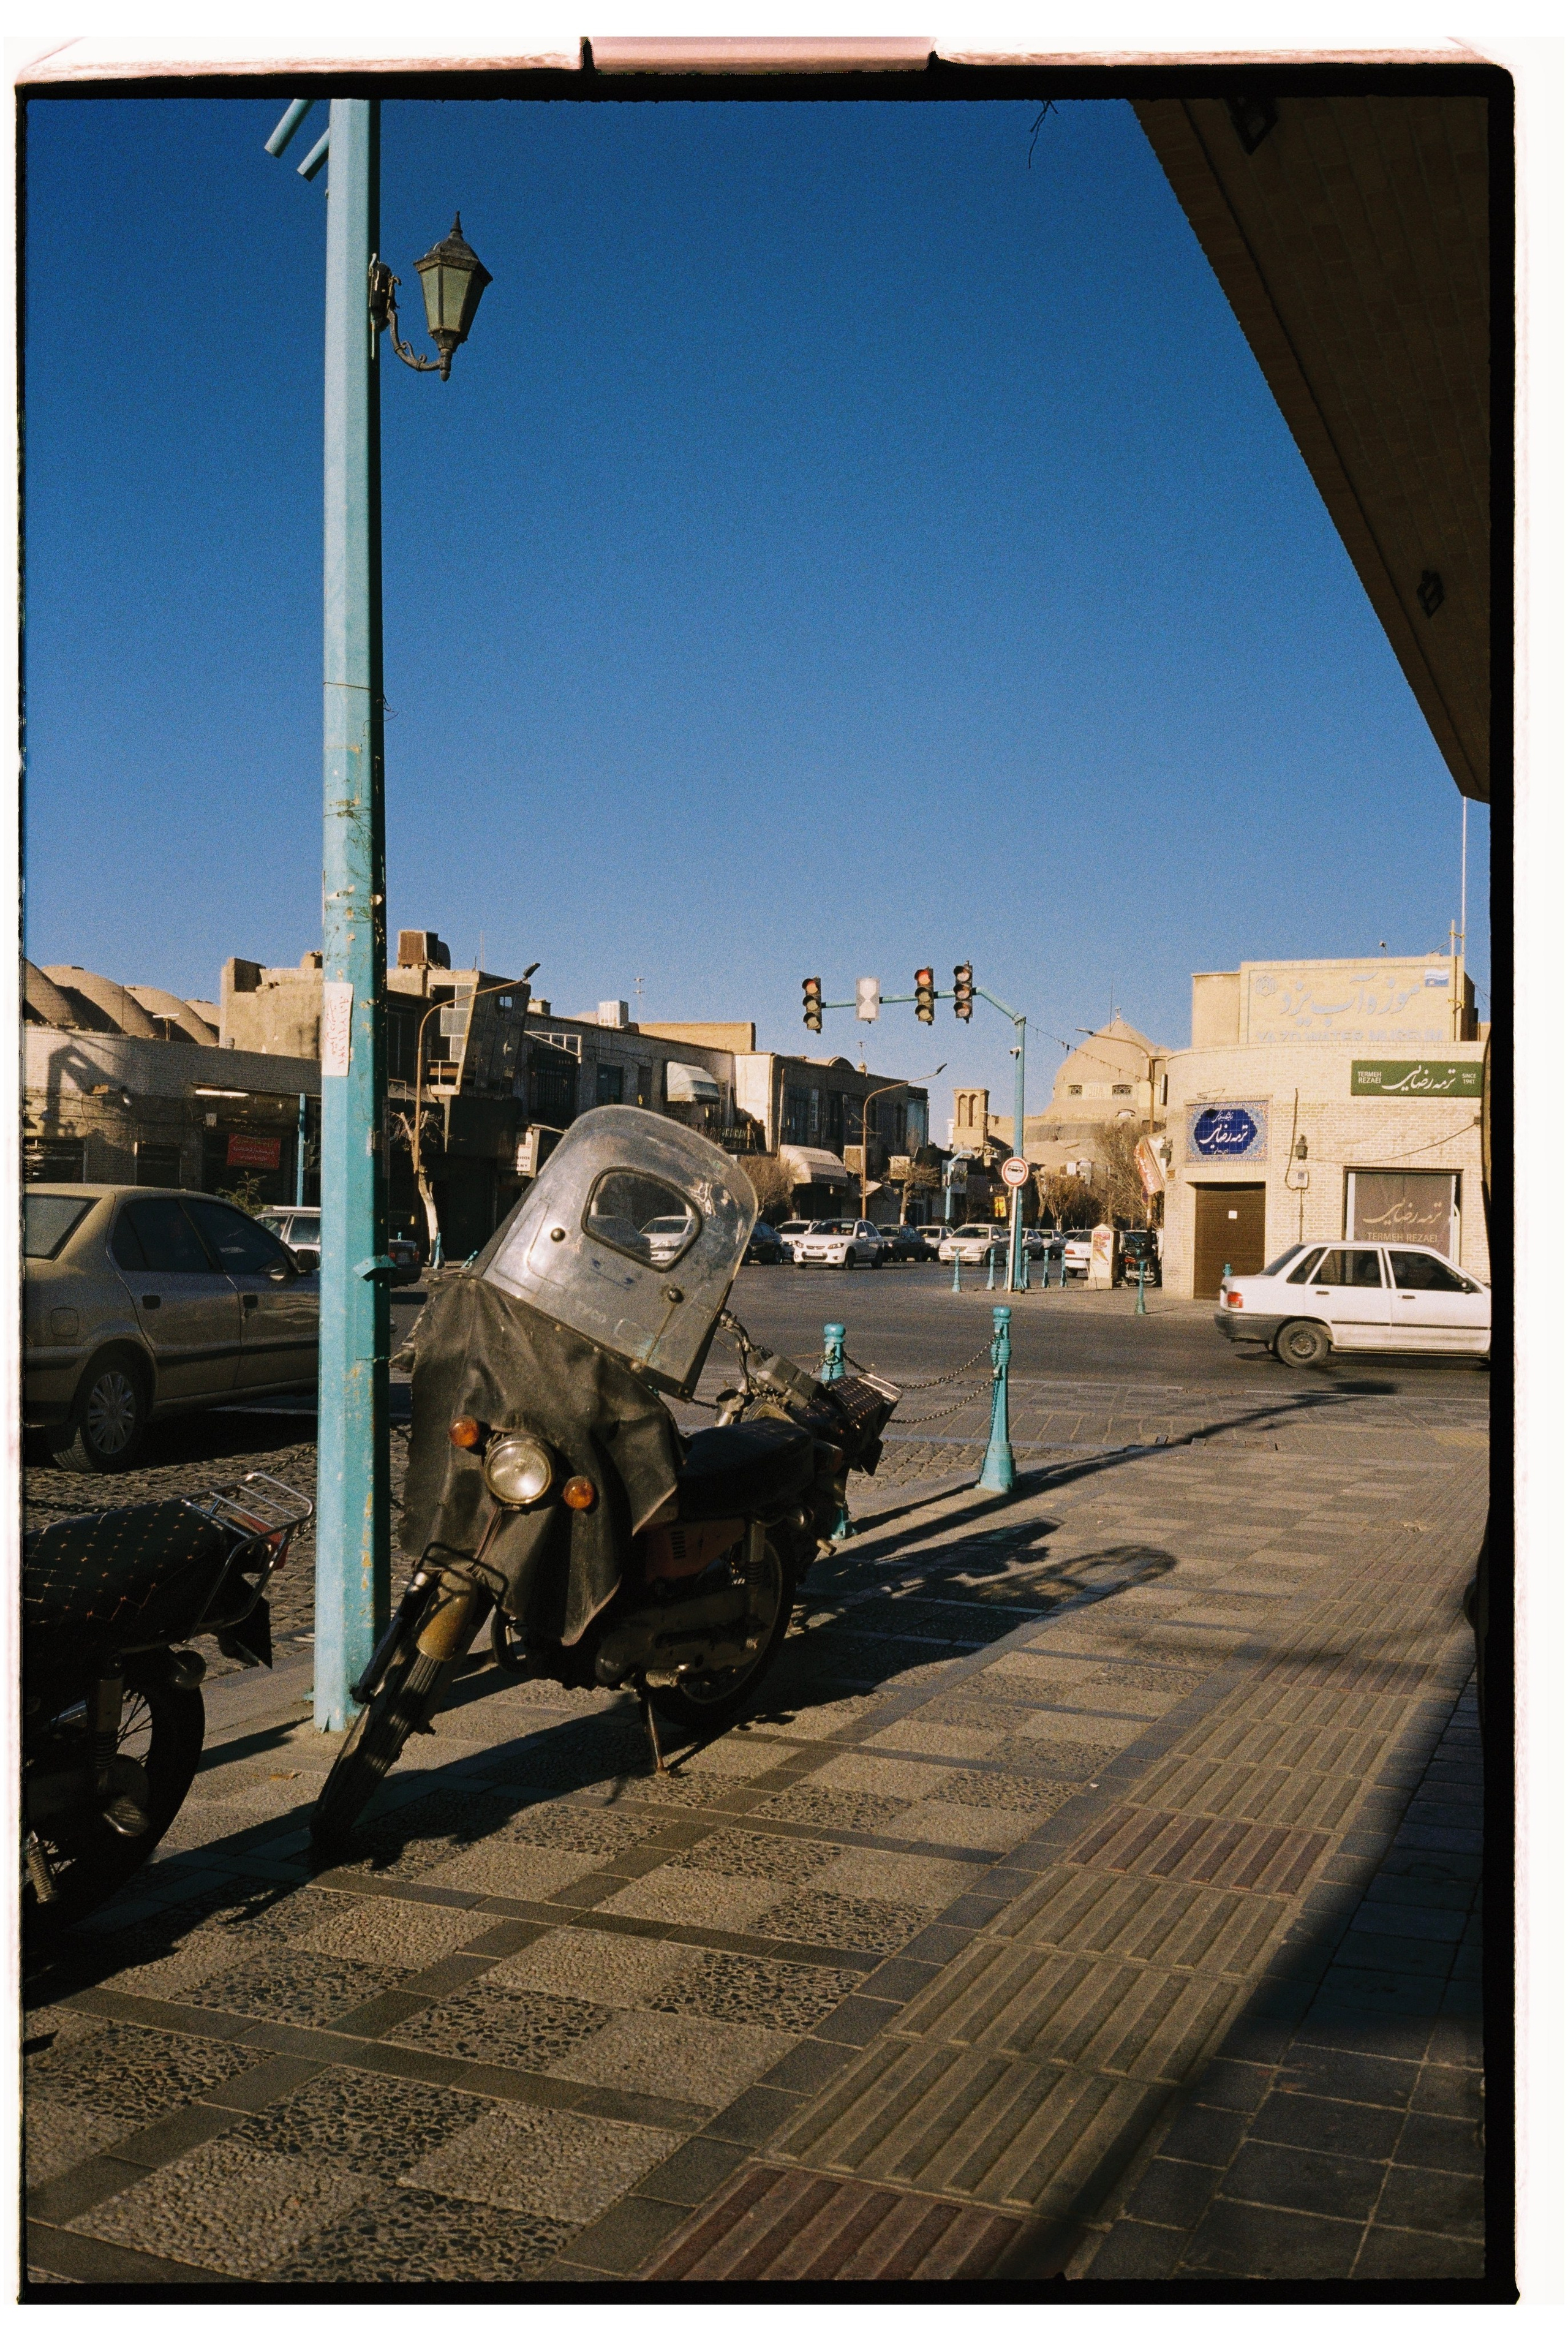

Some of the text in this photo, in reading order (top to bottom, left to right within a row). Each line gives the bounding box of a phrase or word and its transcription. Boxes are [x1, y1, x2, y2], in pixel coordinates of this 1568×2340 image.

[1280, 972, 1420, 1027] موزه آب یزد
[1256, 1029, 1443, 1041] YAZD WATER MUSEUM
[1381, 1065, 1456, 1091] ترمه رضایی
[1230, 1124, 1248, 1142] ترمه
[1417, 1201, 1442, 1223] ترمه
[1366, 1232, 1438, 1243] TERMEH REZAEI
